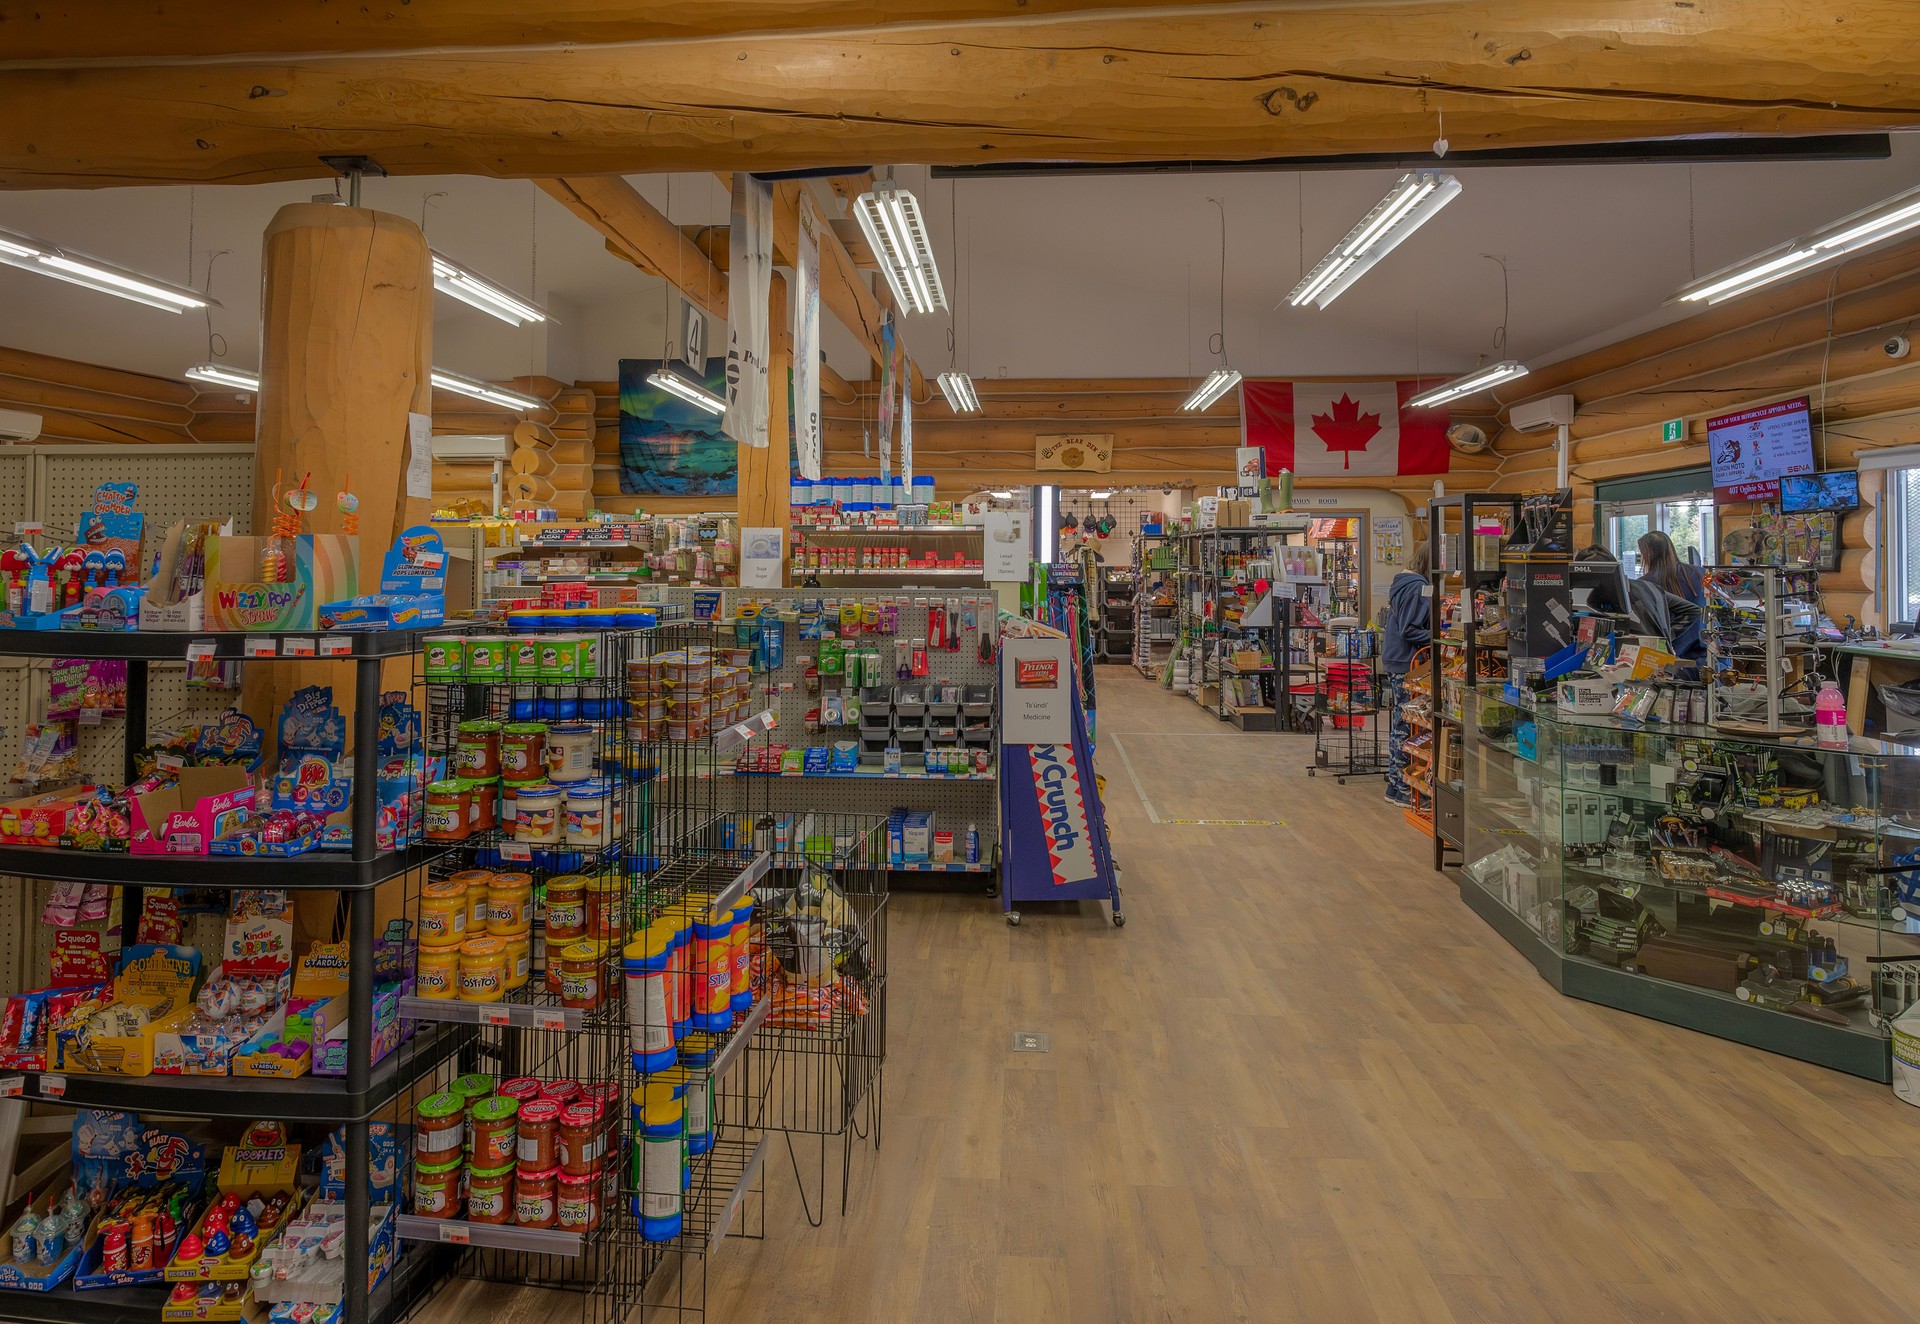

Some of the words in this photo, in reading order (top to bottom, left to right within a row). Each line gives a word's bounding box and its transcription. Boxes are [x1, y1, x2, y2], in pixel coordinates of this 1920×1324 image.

[688, 318, 700, 365] 4
[1741, 410, 1767, 420] MOTORCYCLE
[1050, 442, 1062, 451] THE
[1086, 442, 1098, 452] DEN
[1787, 464, 1810, 473] SENA
[96, 491, 126, 504] CHATTY
[1729, 487, 1738, 495] 407
[218, 590, 266, 609] WIZZY
[268, 592, 292, 608] POP
[240, 608, 279, 626] Straws
[304, 691, 321, 702] Big
[296, 697, 328, 714] Dipper
[458, 752, 476, 763] STiTOS
[212, 796, 232, 812] Barbie
[1042, 764, 1079, 850] Crunch
[1, 818, 50, 836] FIZZ
[173, 815, 200, 829] Barbie
[243, 929, 273, 941] kinder
[232, 935, 283, 956] SURPRISE
[130, 960, 159, 974] GOLD
[160, 960, 191, 974] MINE
[305, 959, 349, 968] STARDUST
[250, 1063, 282, 1071] STARDUST
[150, 1135, 168, 1146] BLAST
[235, 1148, 286, 1161] POOPLETS
[2, 1268, 16, 1276] Big
